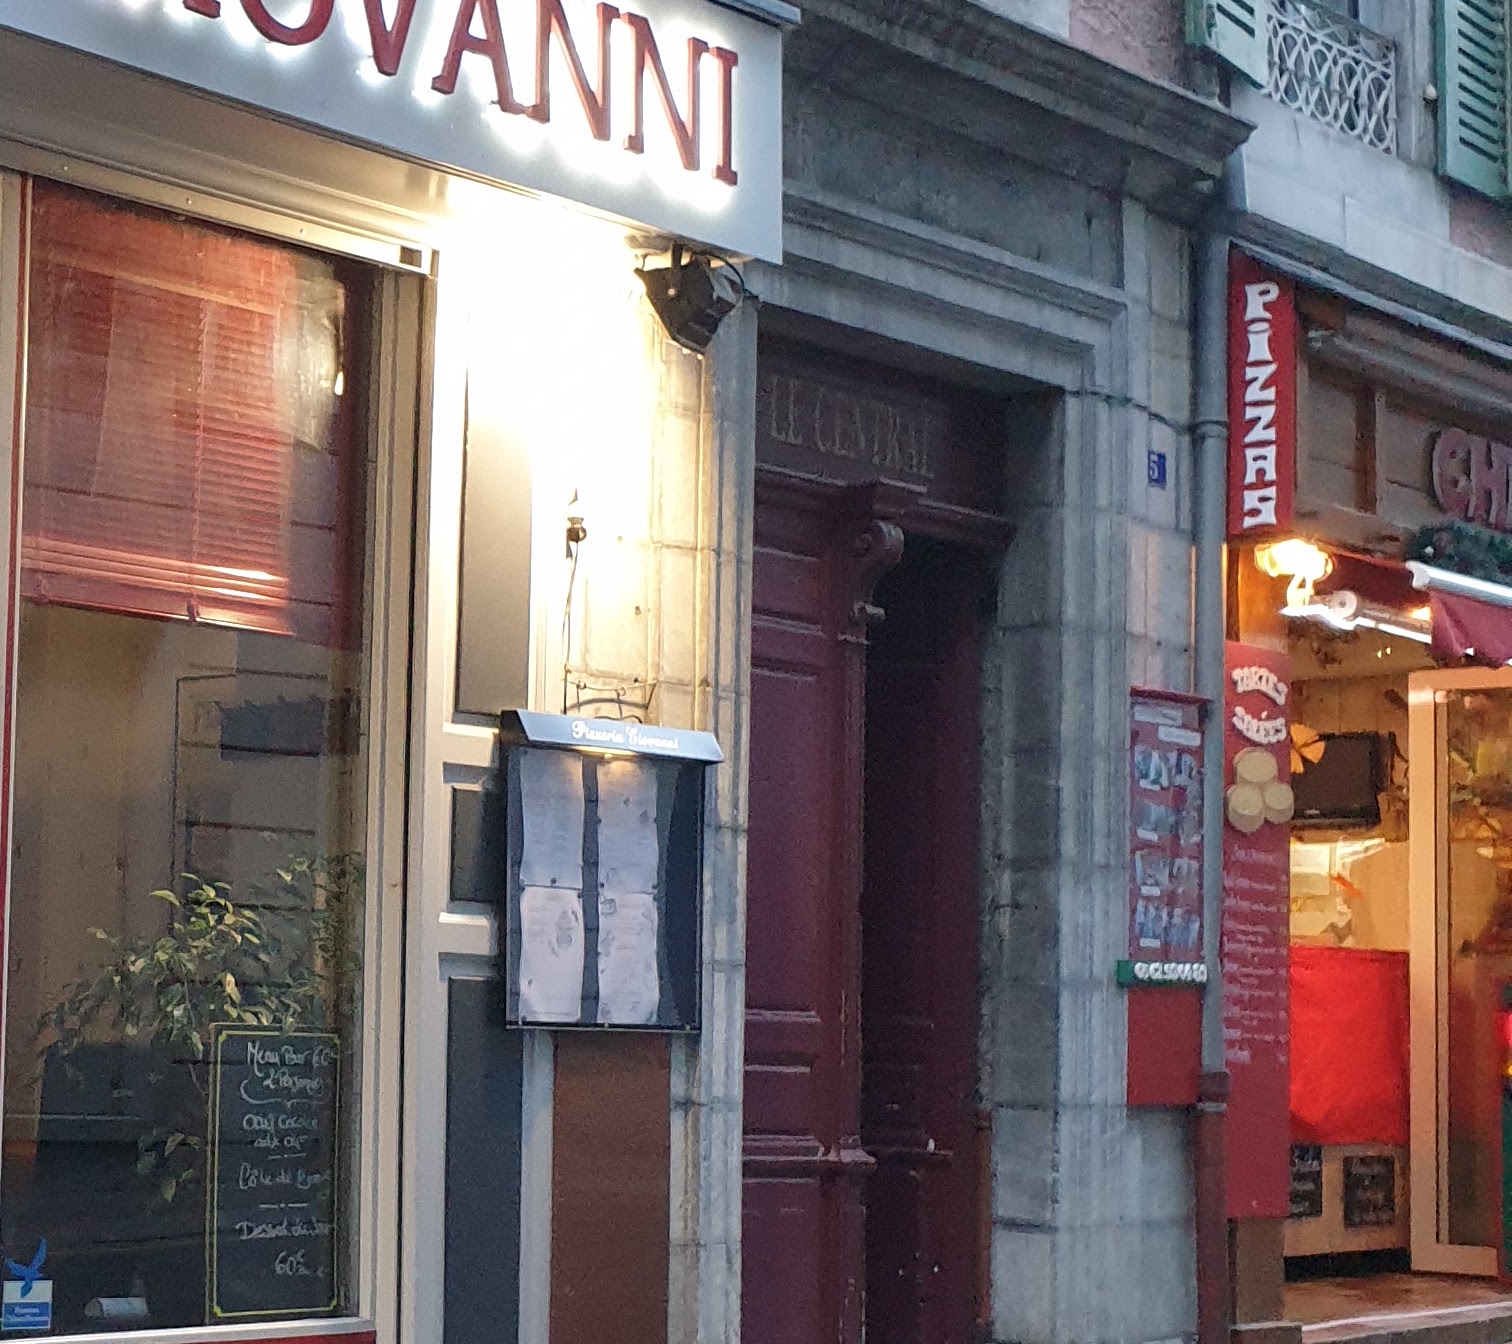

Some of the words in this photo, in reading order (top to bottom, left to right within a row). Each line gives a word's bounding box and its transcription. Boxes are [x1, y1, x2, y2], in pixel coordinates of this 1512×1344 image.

[1431, 426, 1512, 534] CH
[571, 720, 625, 744] Pizzeria
[625, 725, 680, 749] Giovanni
